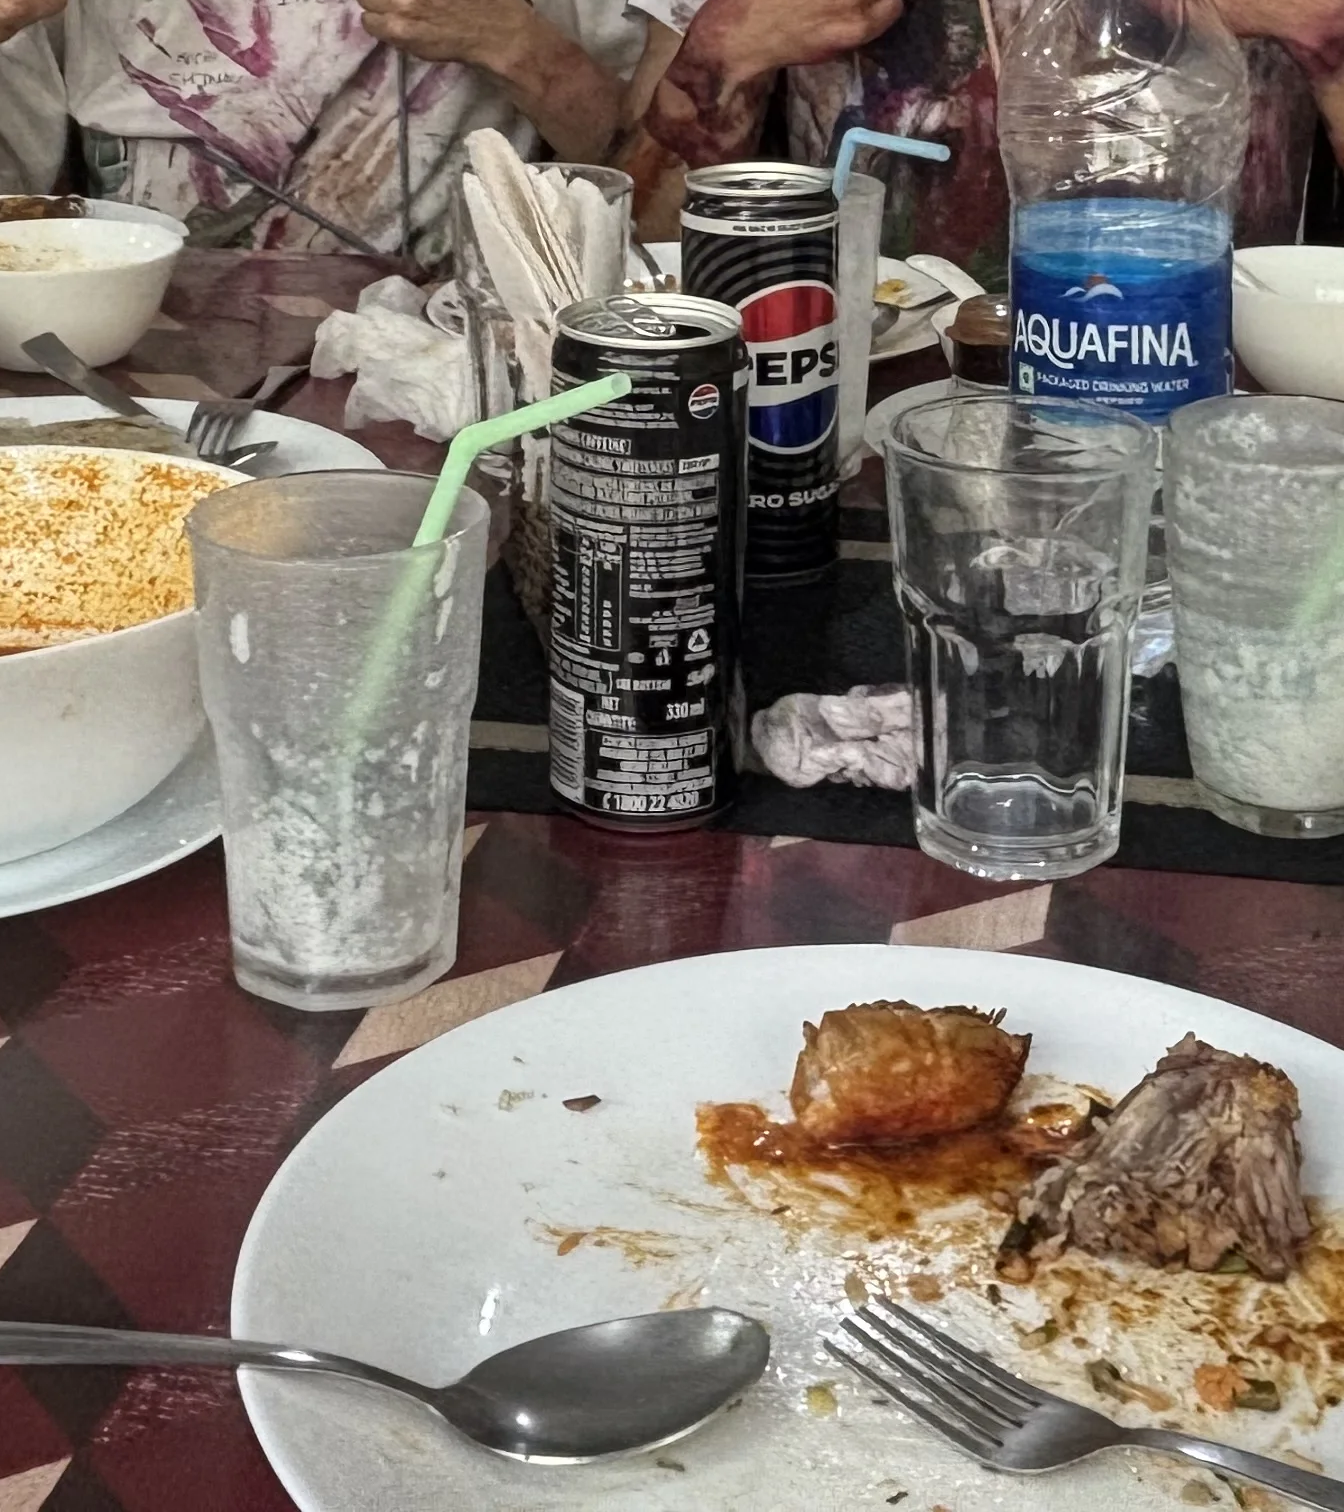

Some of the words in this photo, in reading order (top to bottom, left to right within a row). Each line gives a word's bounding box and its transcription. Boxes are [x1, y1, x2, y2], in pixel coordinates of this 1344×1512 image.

[1014, 308, 1197, 369] AQUAFINA
[748, 341, 838, 386] EPS
[748, 494, 784, 508] RO
[788, 481, 839, 507] SUG
[666, 702, 688, 721] 330
